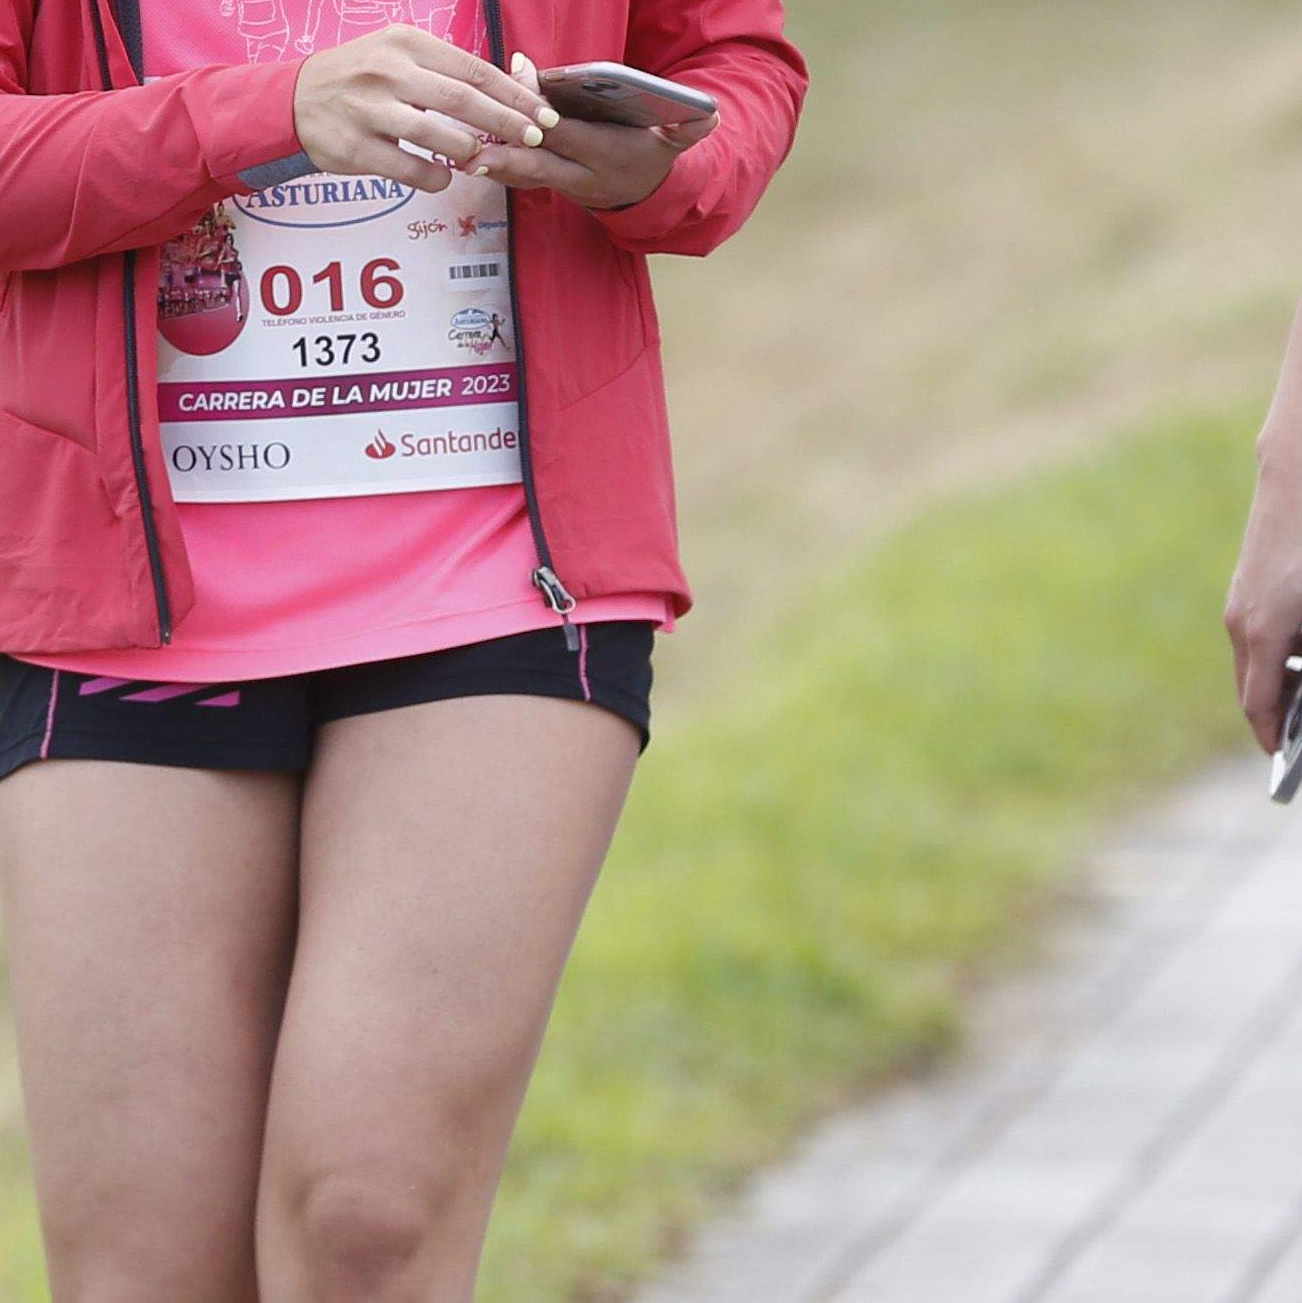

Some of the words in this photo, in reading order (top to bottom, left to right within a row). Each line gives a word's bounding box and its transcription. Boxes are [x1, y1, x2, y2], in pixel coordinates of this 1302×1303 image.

[259, 257, 405, 317] 016
[261, 316, 308, 328] TELÉFONO
[308, 313, 355, 325] VIOLENCIA
[355, 312, 369, 321] DE
[369, 309, 406, 320] GÉNERO
[291, 332, 382, 368] 1373
[178, 389, 286, 413] CARRERA
[291, 386, 327, 408] DE
[331, 384, 364, 406] LA
[369, 378, 453, 404] MUJER
[461, 373, 511, 397] 2023
[172, 441, 292, 473] OYSHO
[400, 426, 521, 458] Santande
